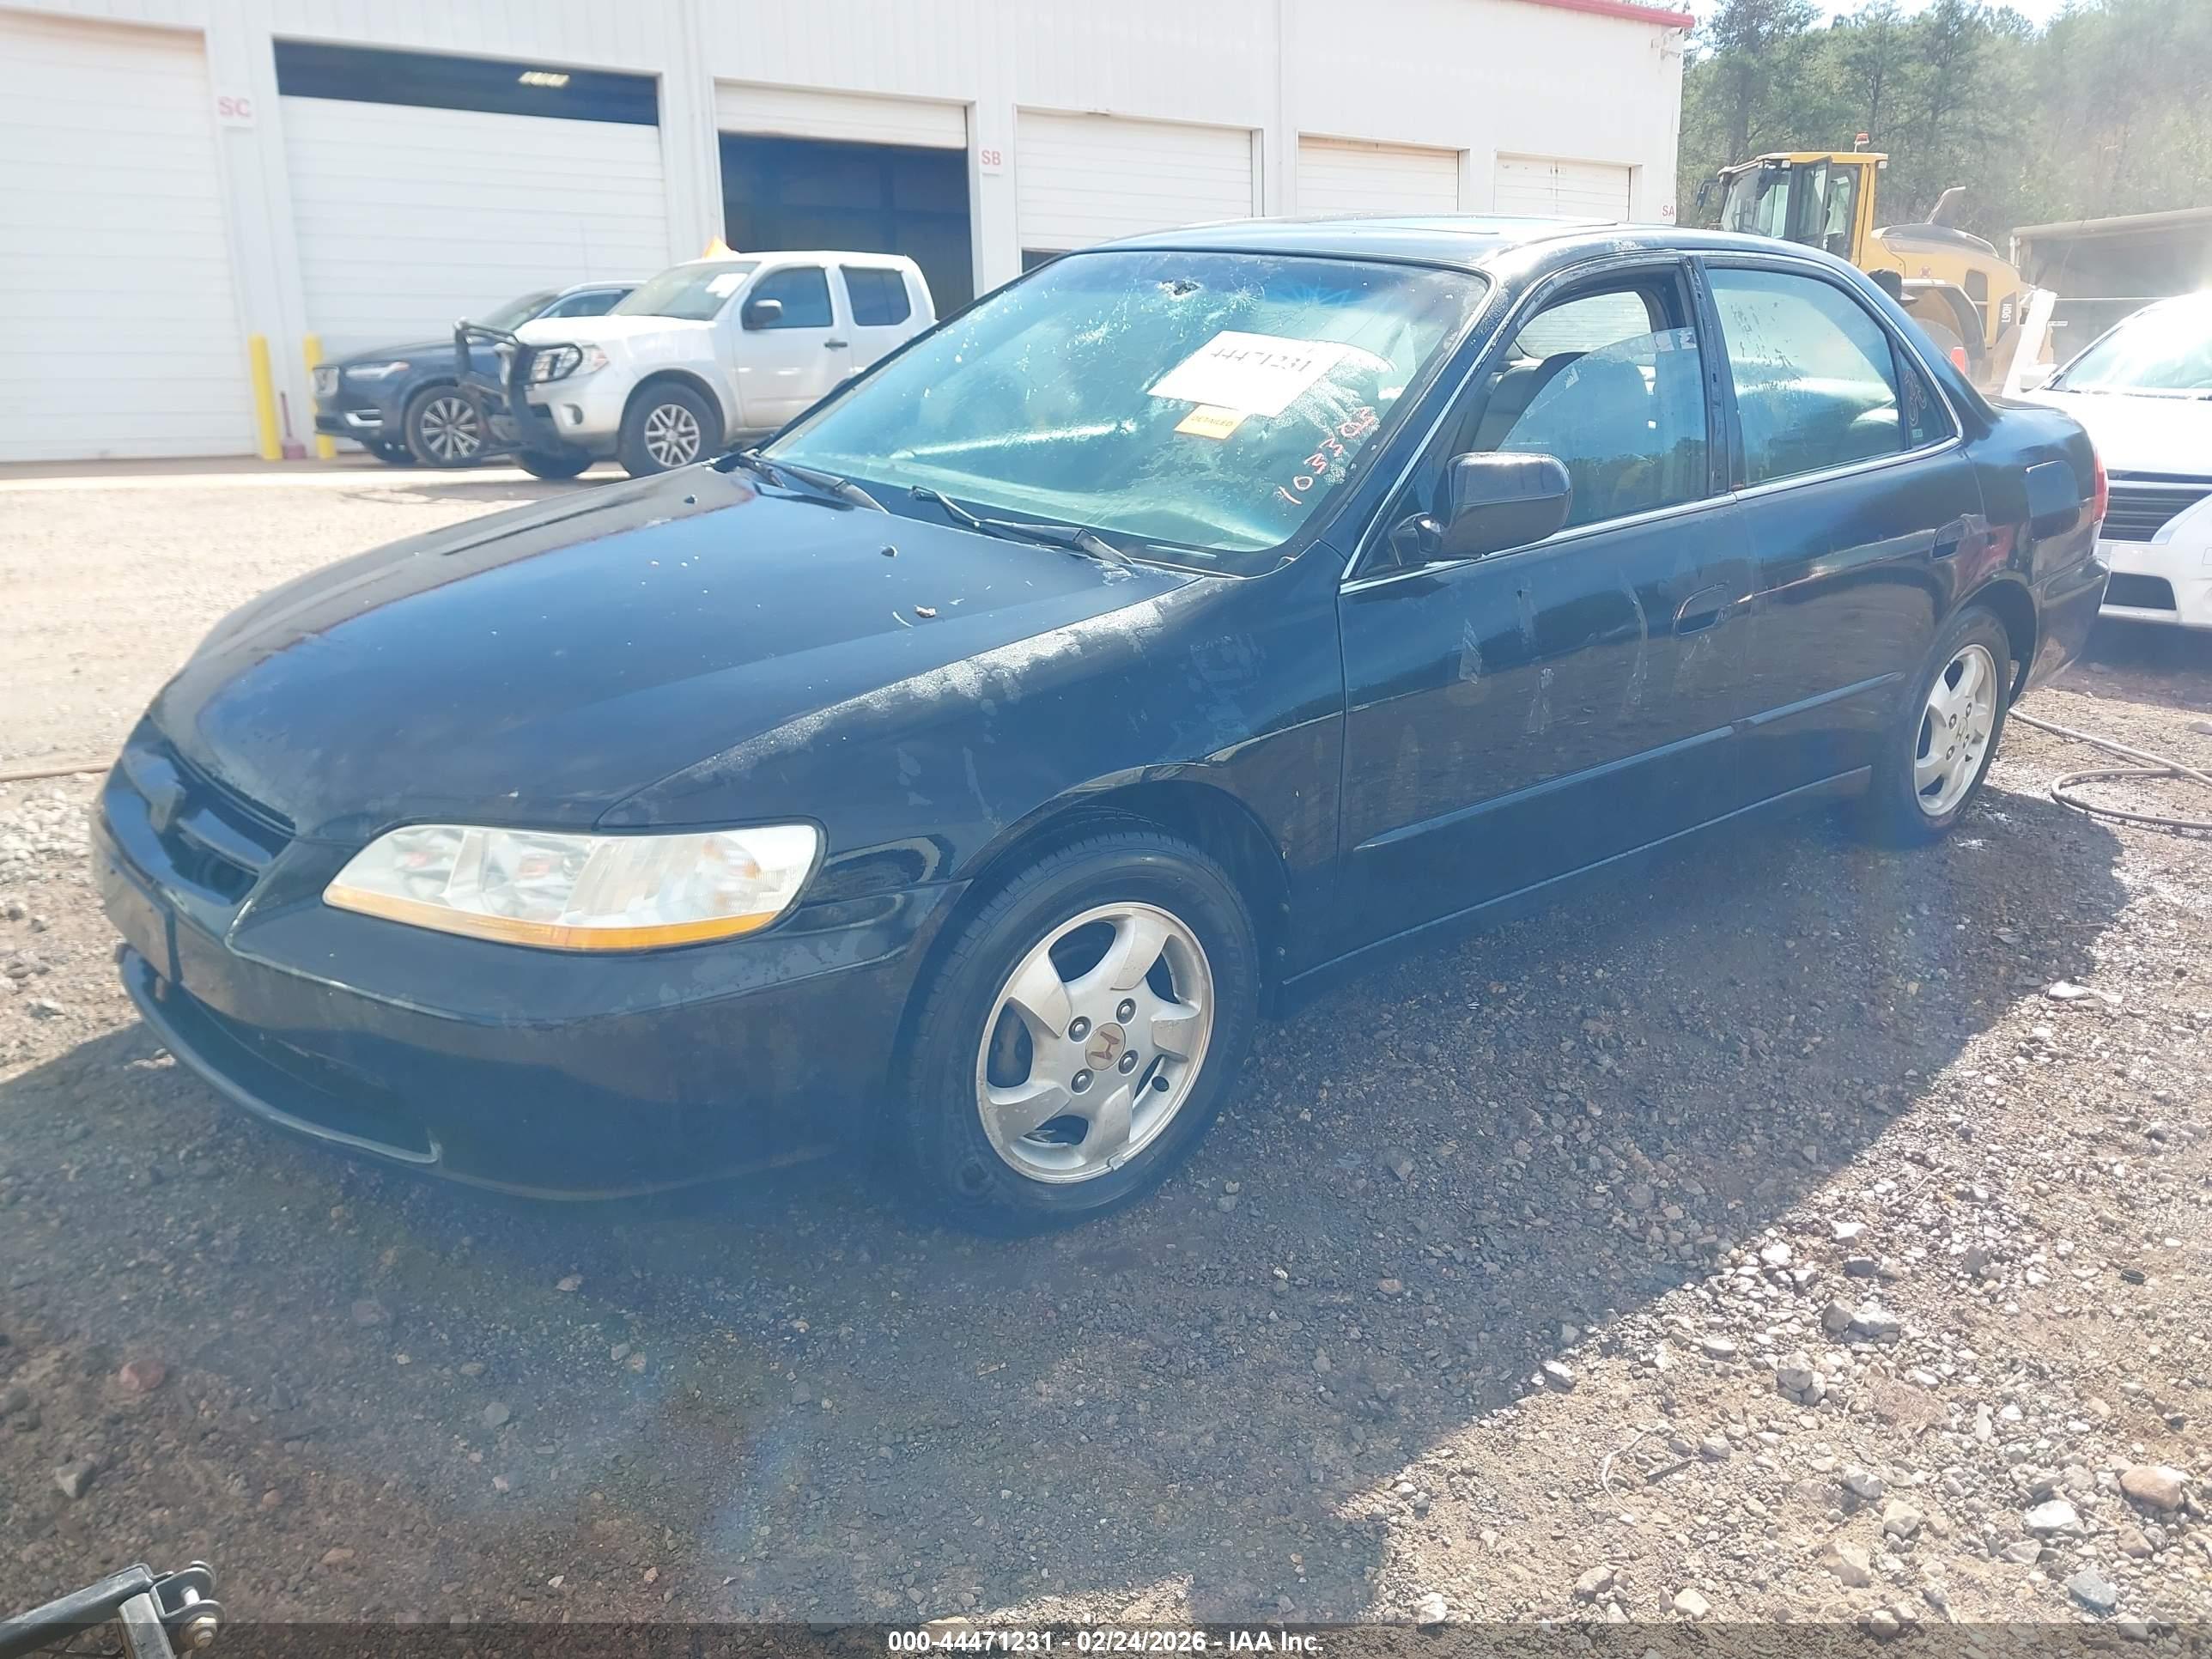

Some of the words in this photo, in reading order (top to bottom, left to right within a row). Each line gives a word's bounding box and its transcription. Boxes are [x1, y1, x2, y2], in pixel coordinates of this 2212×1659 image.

[219, 96, 251, 117] SC
[981, 149, 1001, 165] SB
[1662, 205, 1674, 216] SA
[2002, 303, 2012, 322] L90H
